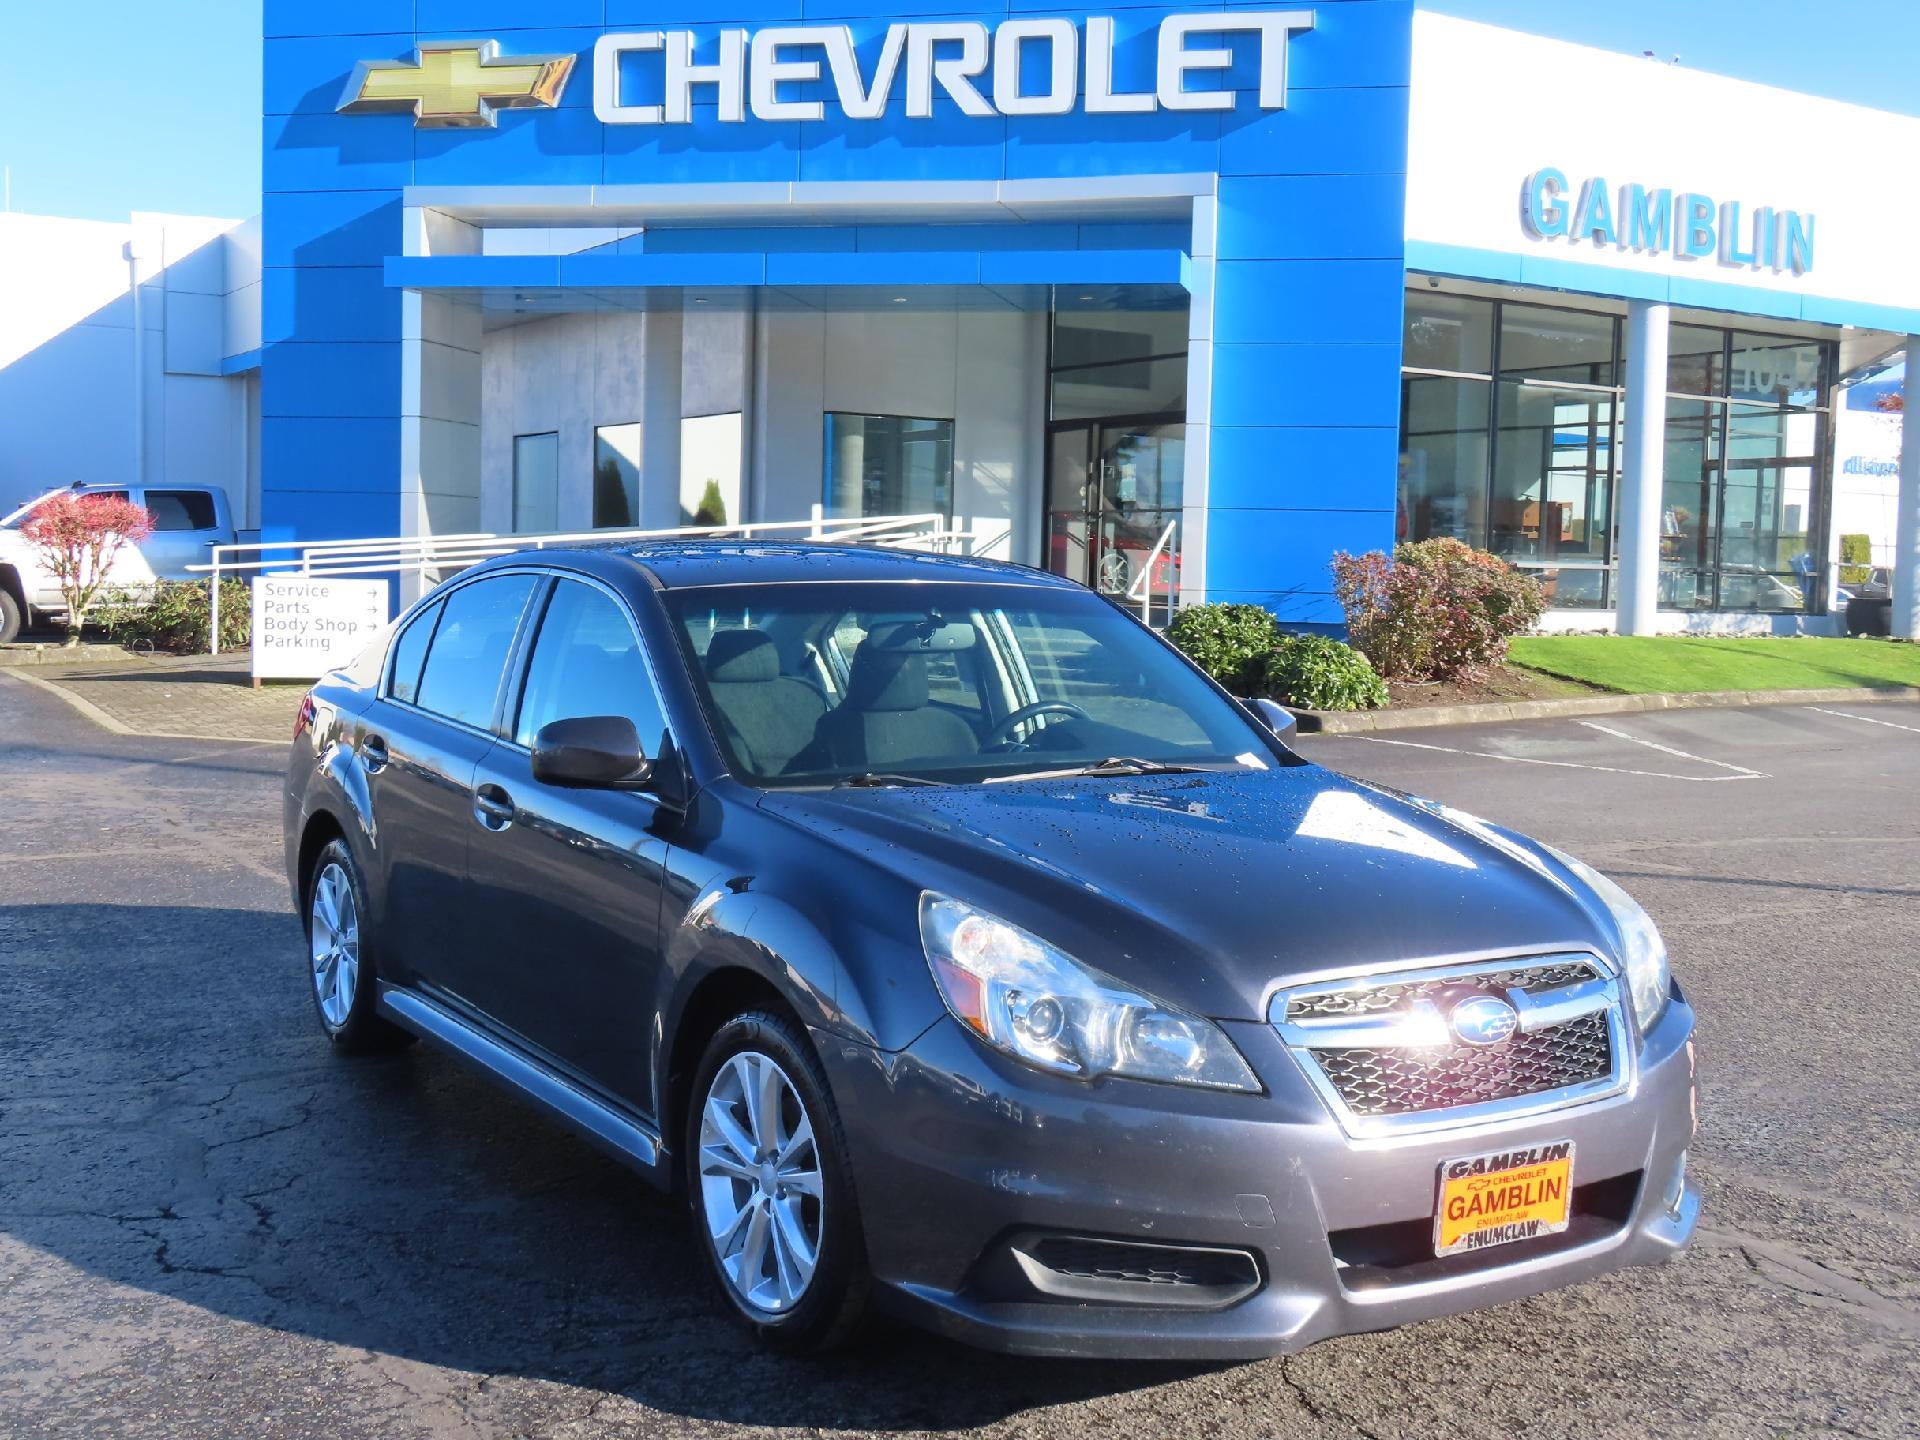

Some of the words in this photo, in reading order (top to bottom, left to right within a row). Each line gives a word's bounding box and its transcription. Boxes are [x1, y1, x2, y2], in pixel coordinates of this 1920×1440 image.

[592, 10, 1315, 125] CHEVROLET
[1519, 167, 1815, 278] GAMBLIN
[265, 582, 330, 598] Service
[264, 600, 310, 614] Parts
[264, 617, 309, 635] Body
[315, 618, 358, 636] Shop
[264, 634, 330, 652] Parking
[1448, 1142, 1570, 1179] GAMBLIN
[1493, 1167, 1548, 1186] CHEVROLET
[1447, 1176, 1562, 1221] GAMBLIN
[1476, 1210, 1530, 1229] ENUMCLAW
[1467, 1219, 1540, 1249] ENUMCLAW
